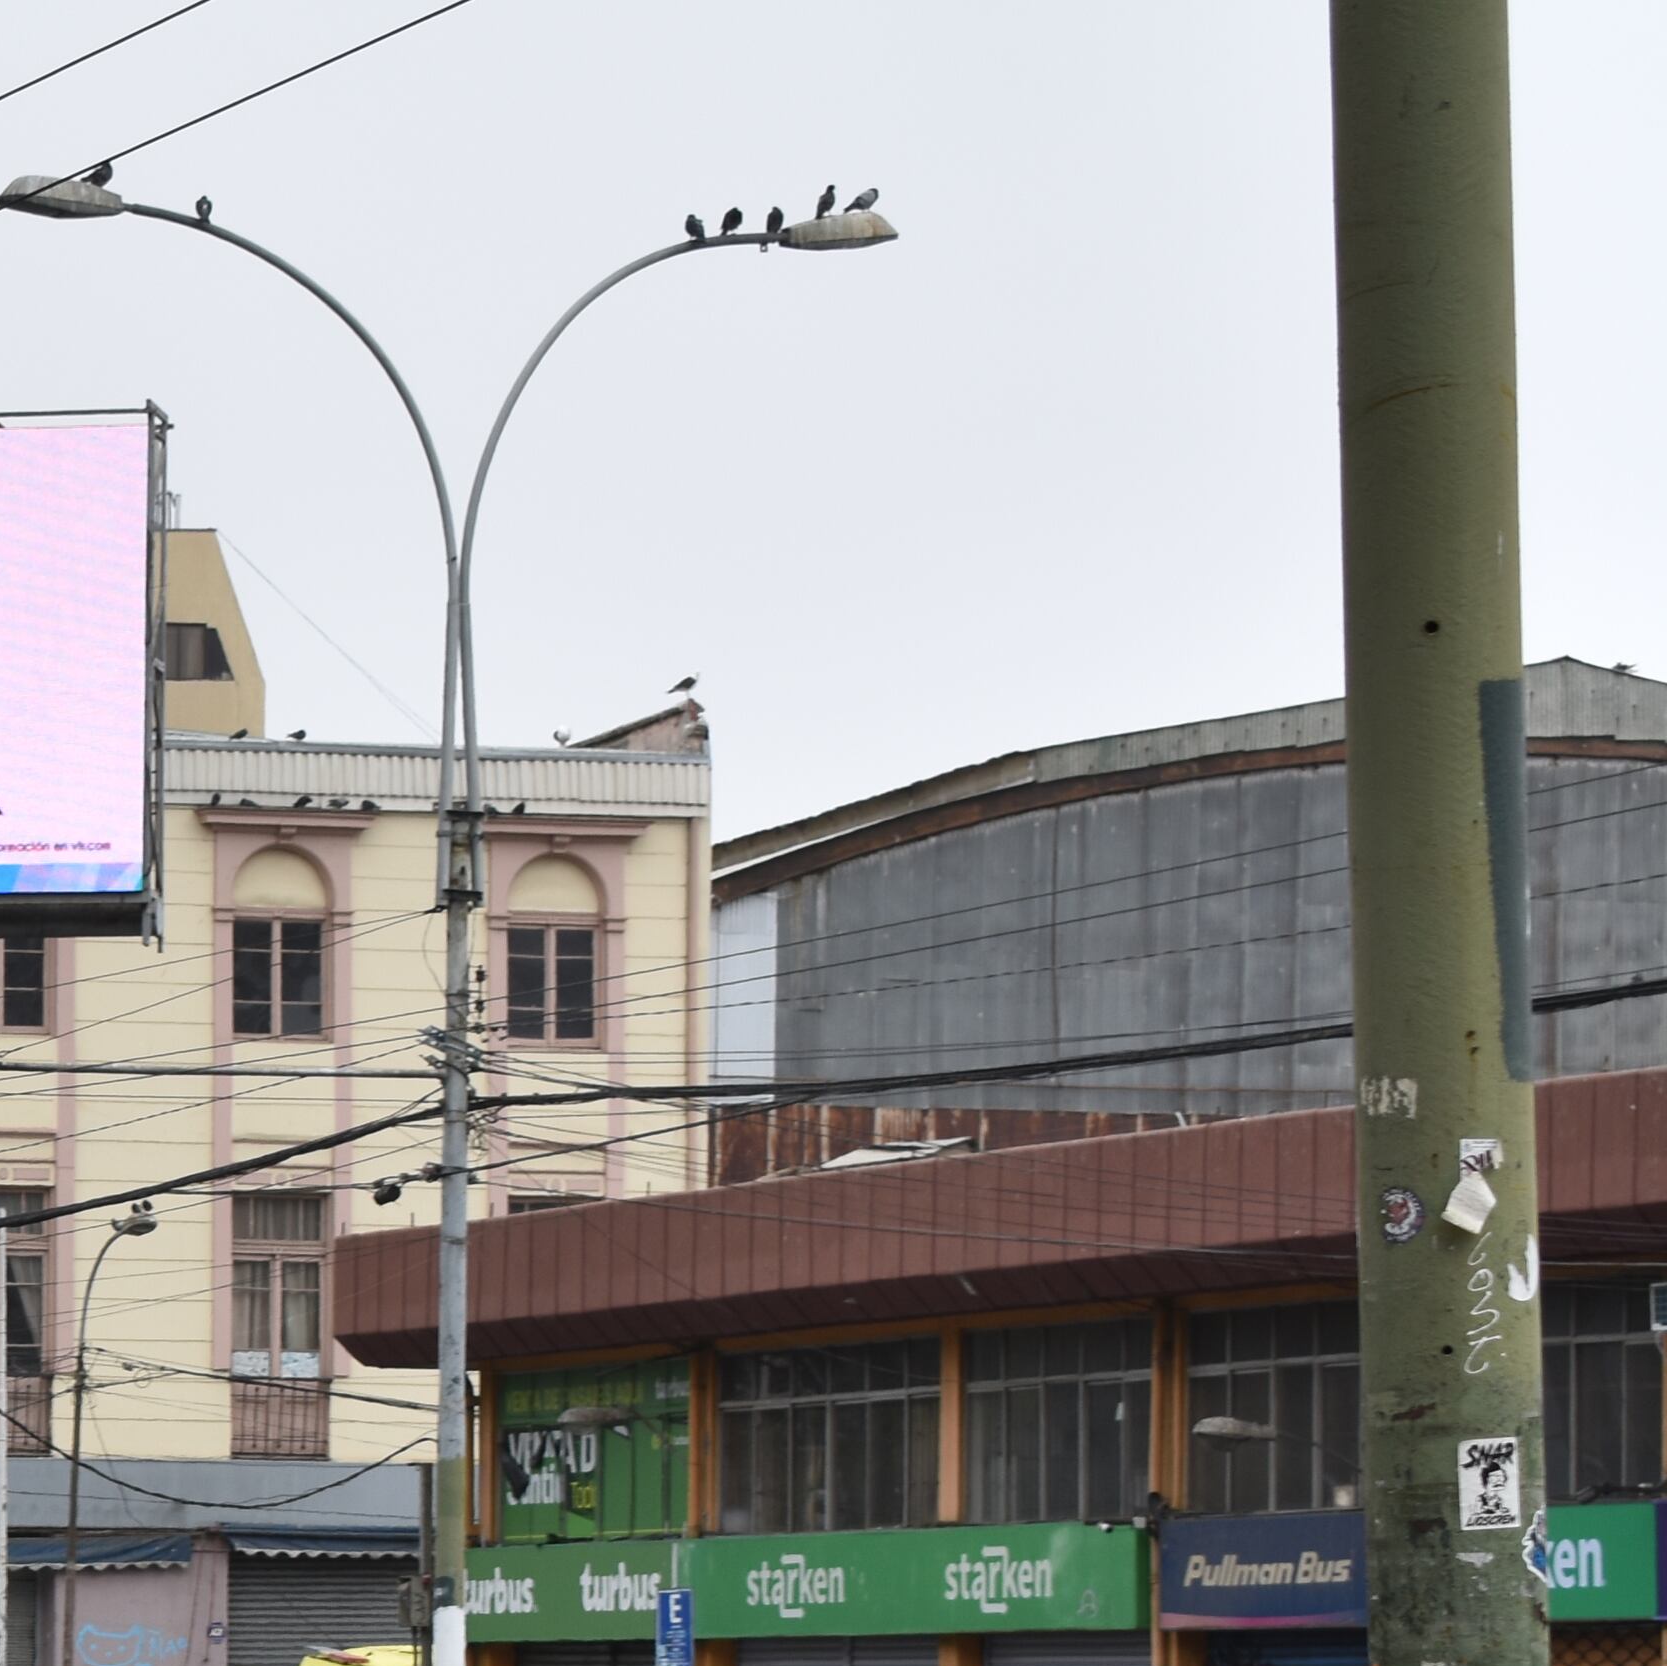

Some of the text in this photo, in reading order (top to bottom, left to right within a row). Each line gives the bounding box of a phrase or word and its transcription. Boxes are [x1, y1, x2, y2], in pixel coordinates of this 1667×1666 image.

[579, 1561, 662, 1612] turbus
[746, 1553, 845, 1618] starken
[943, 1546, 1053, 1614] starken
[1182, 1550, 1353, 1588] Pullman Bus
[669, 1593, 683, 1624] E
